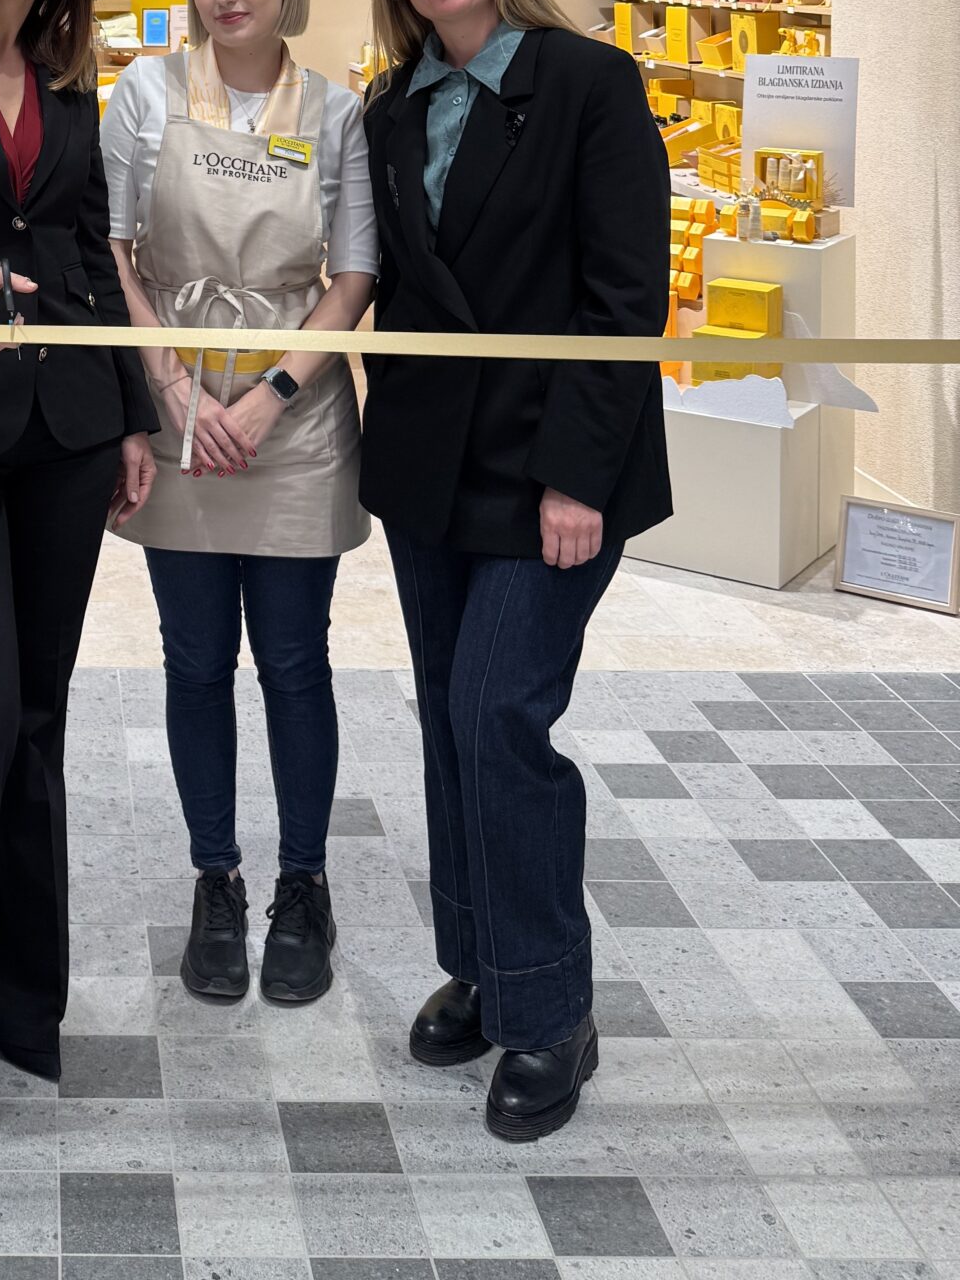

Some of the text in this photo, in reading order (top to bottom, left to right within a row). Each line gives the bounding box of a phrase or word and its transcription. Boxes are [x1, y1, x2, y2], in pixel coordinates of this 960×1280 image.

[777, 65, 825, 76] LIMITIRANA
[758, 77, 844, 90] BLAGDANSKA IZDANJA
[193, 152, 288, 179] L'OCCITANE
[207, 167, 272, 183] EN PROVENCE
